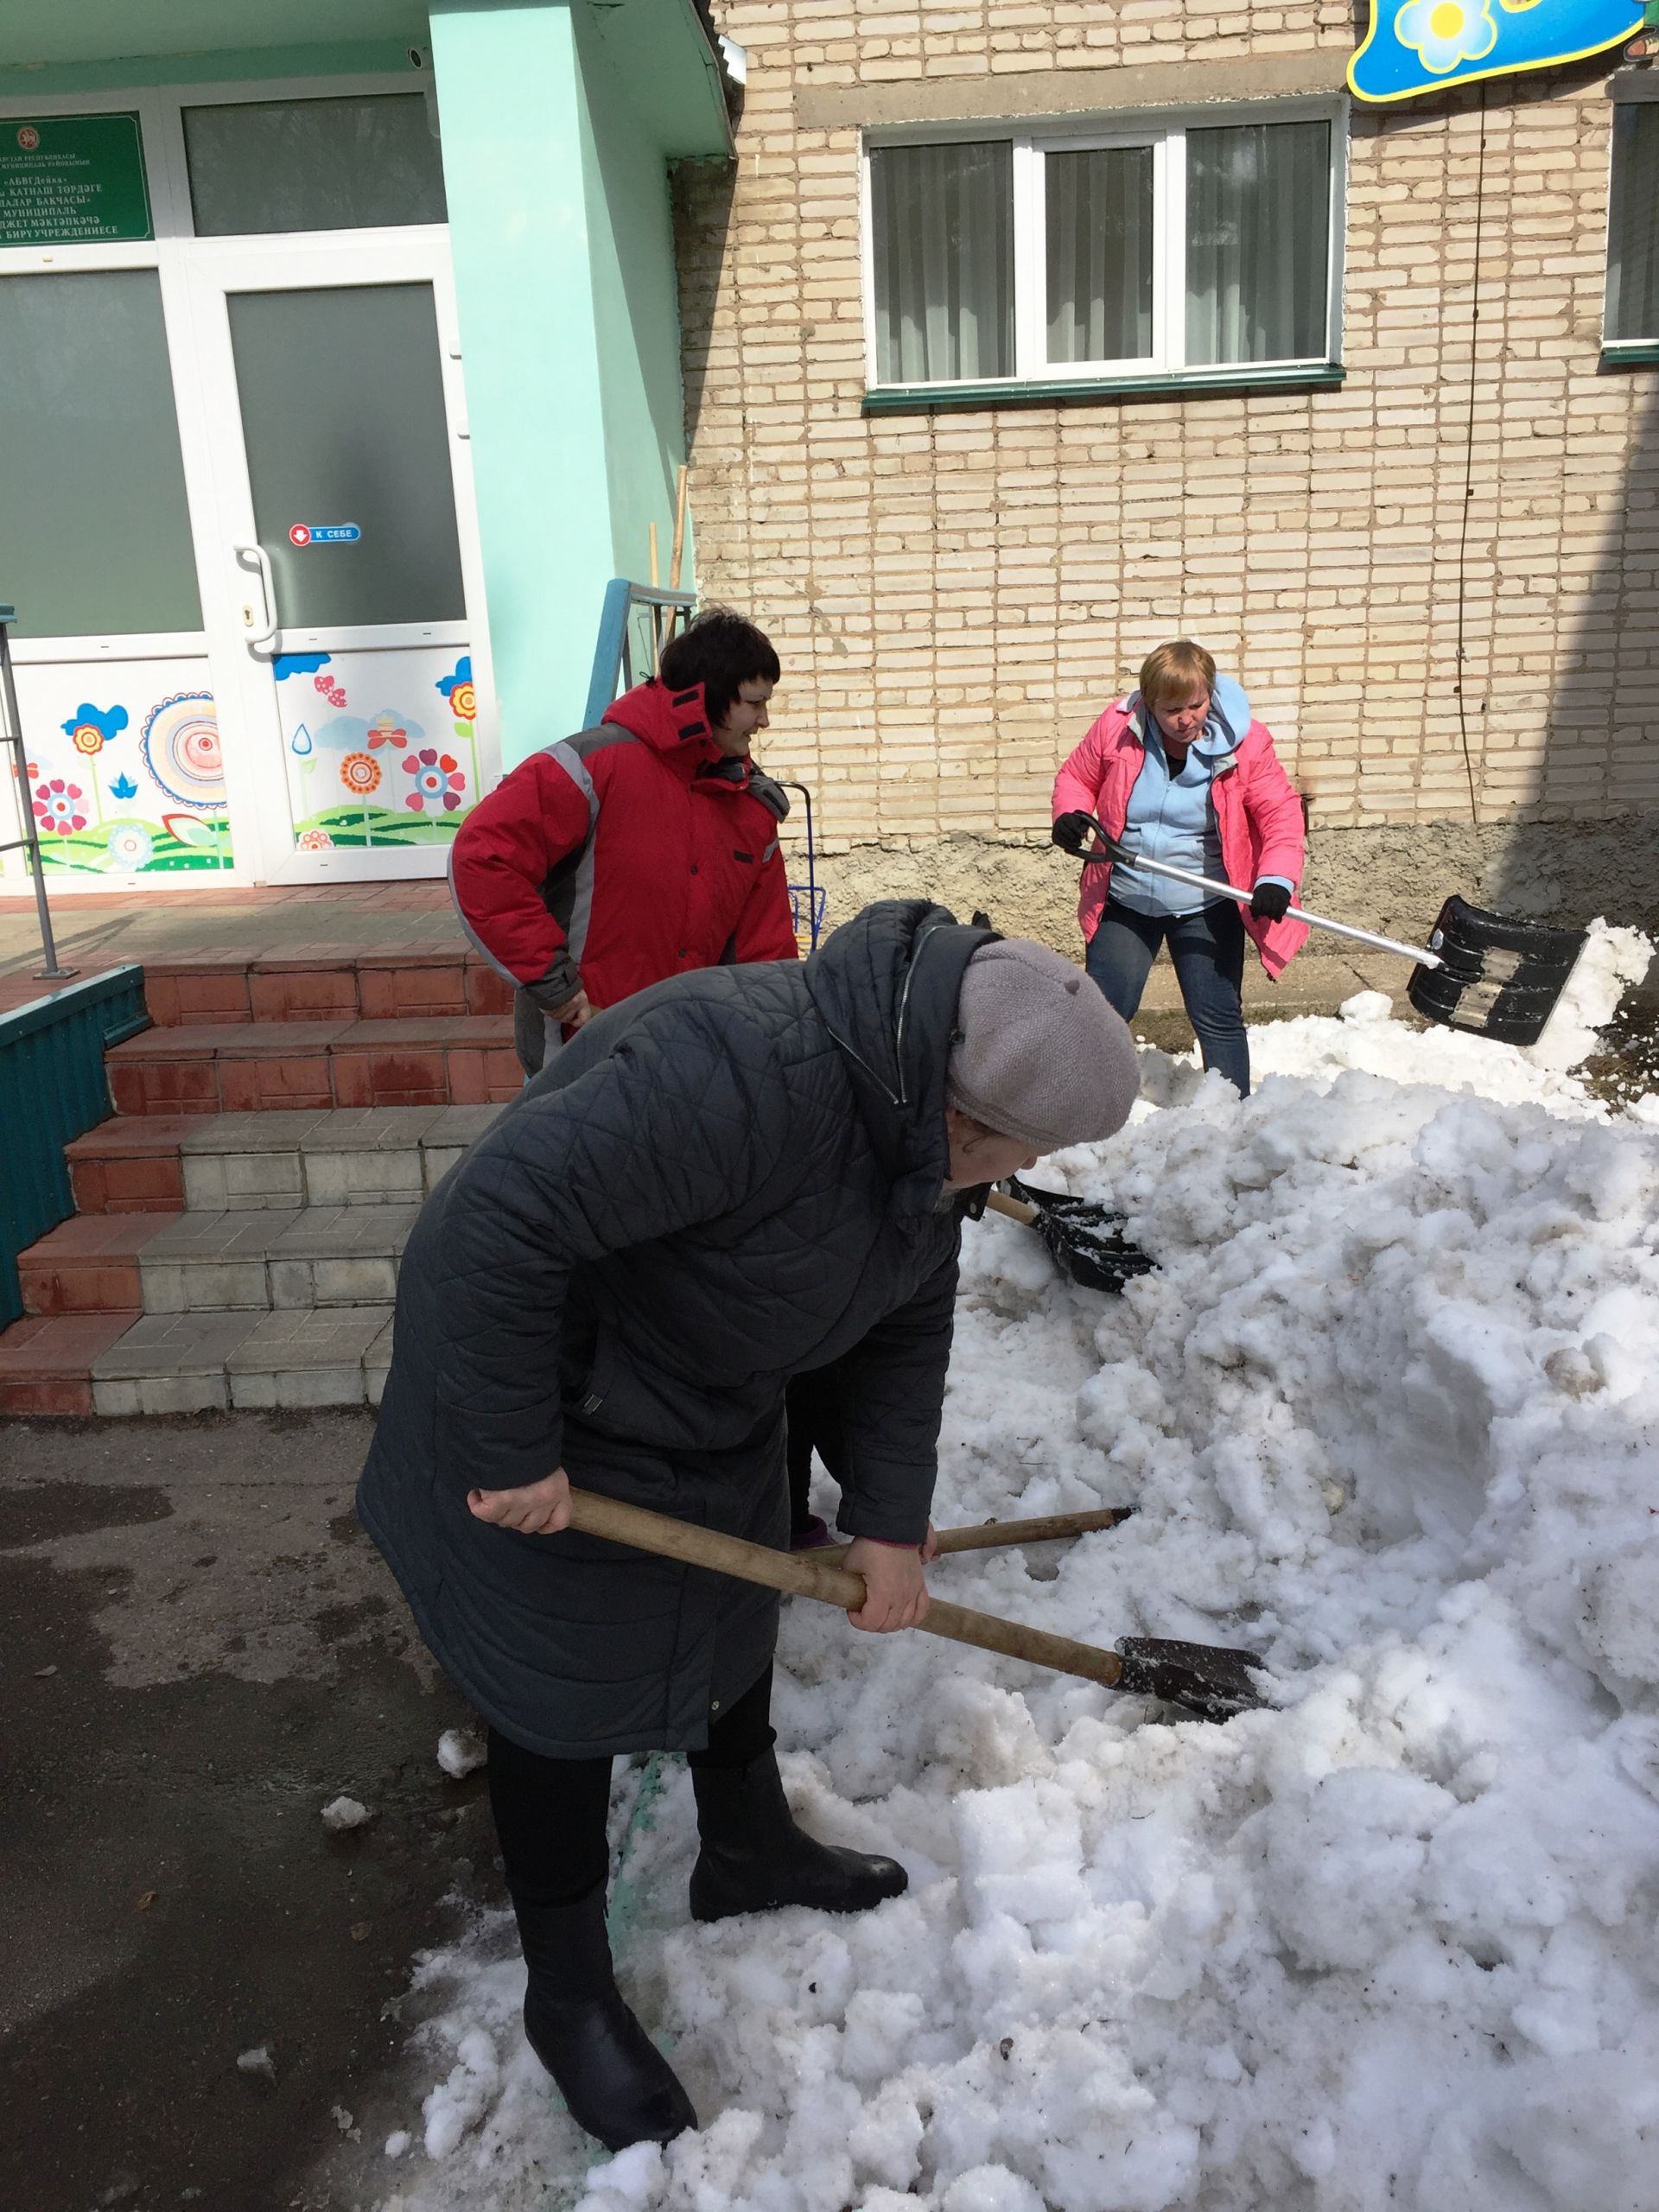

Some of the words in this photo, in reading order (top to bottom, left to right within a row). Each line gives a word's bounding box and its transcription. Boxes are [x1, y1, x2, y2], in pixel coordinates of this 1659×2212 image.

[10, 185, 54, 197] КАТНАШ
[57, 183, 103, 194] ТӨРДӘГЕ
[3, 207, 77, 218] МУНИЦИПАЛЬ
[30, 215, 100, 228] МӘКТӘПКӘЧӘ
[34, 226, 118, 238] УЧРЕЖДЕНИЕСЕ
[315, 531, 322, 539] К
[327, 530, 353, 538] СЕБЕ
